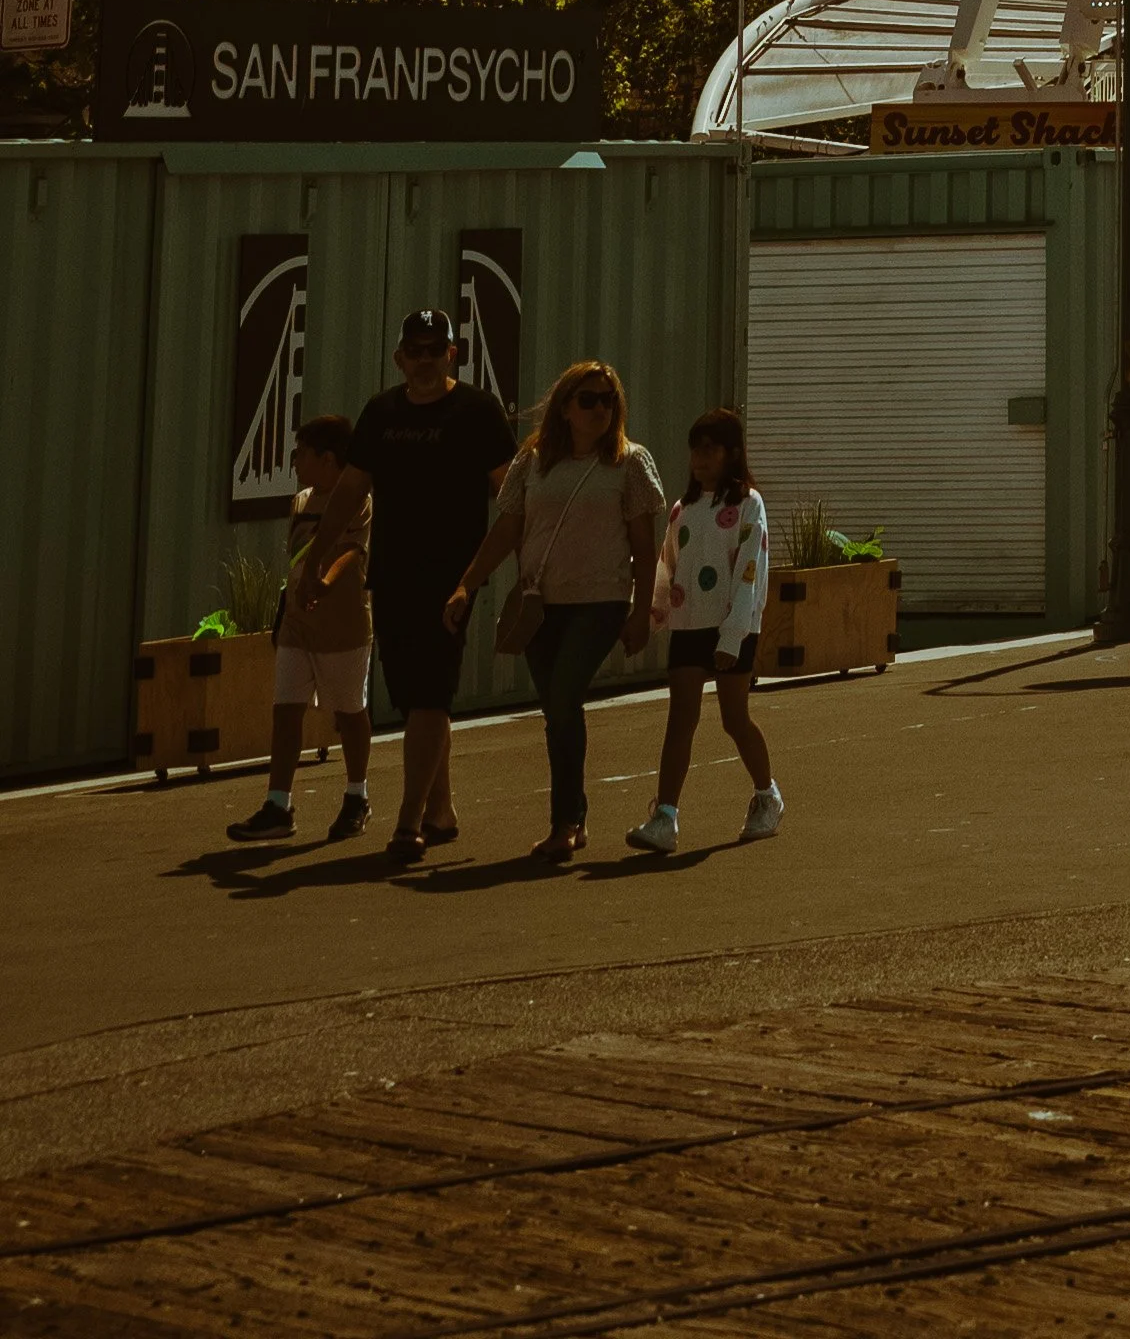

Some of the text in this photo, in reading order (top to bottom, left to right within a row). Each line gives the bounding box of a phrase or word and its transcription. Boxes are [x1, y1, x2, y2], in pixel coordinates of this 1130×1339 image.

[11, 14, 58, 30] ALL TIMES
[211, 41, 576, 103] SAN FRANPSYCHO
[882, 111, 1001, 147] Sunset
